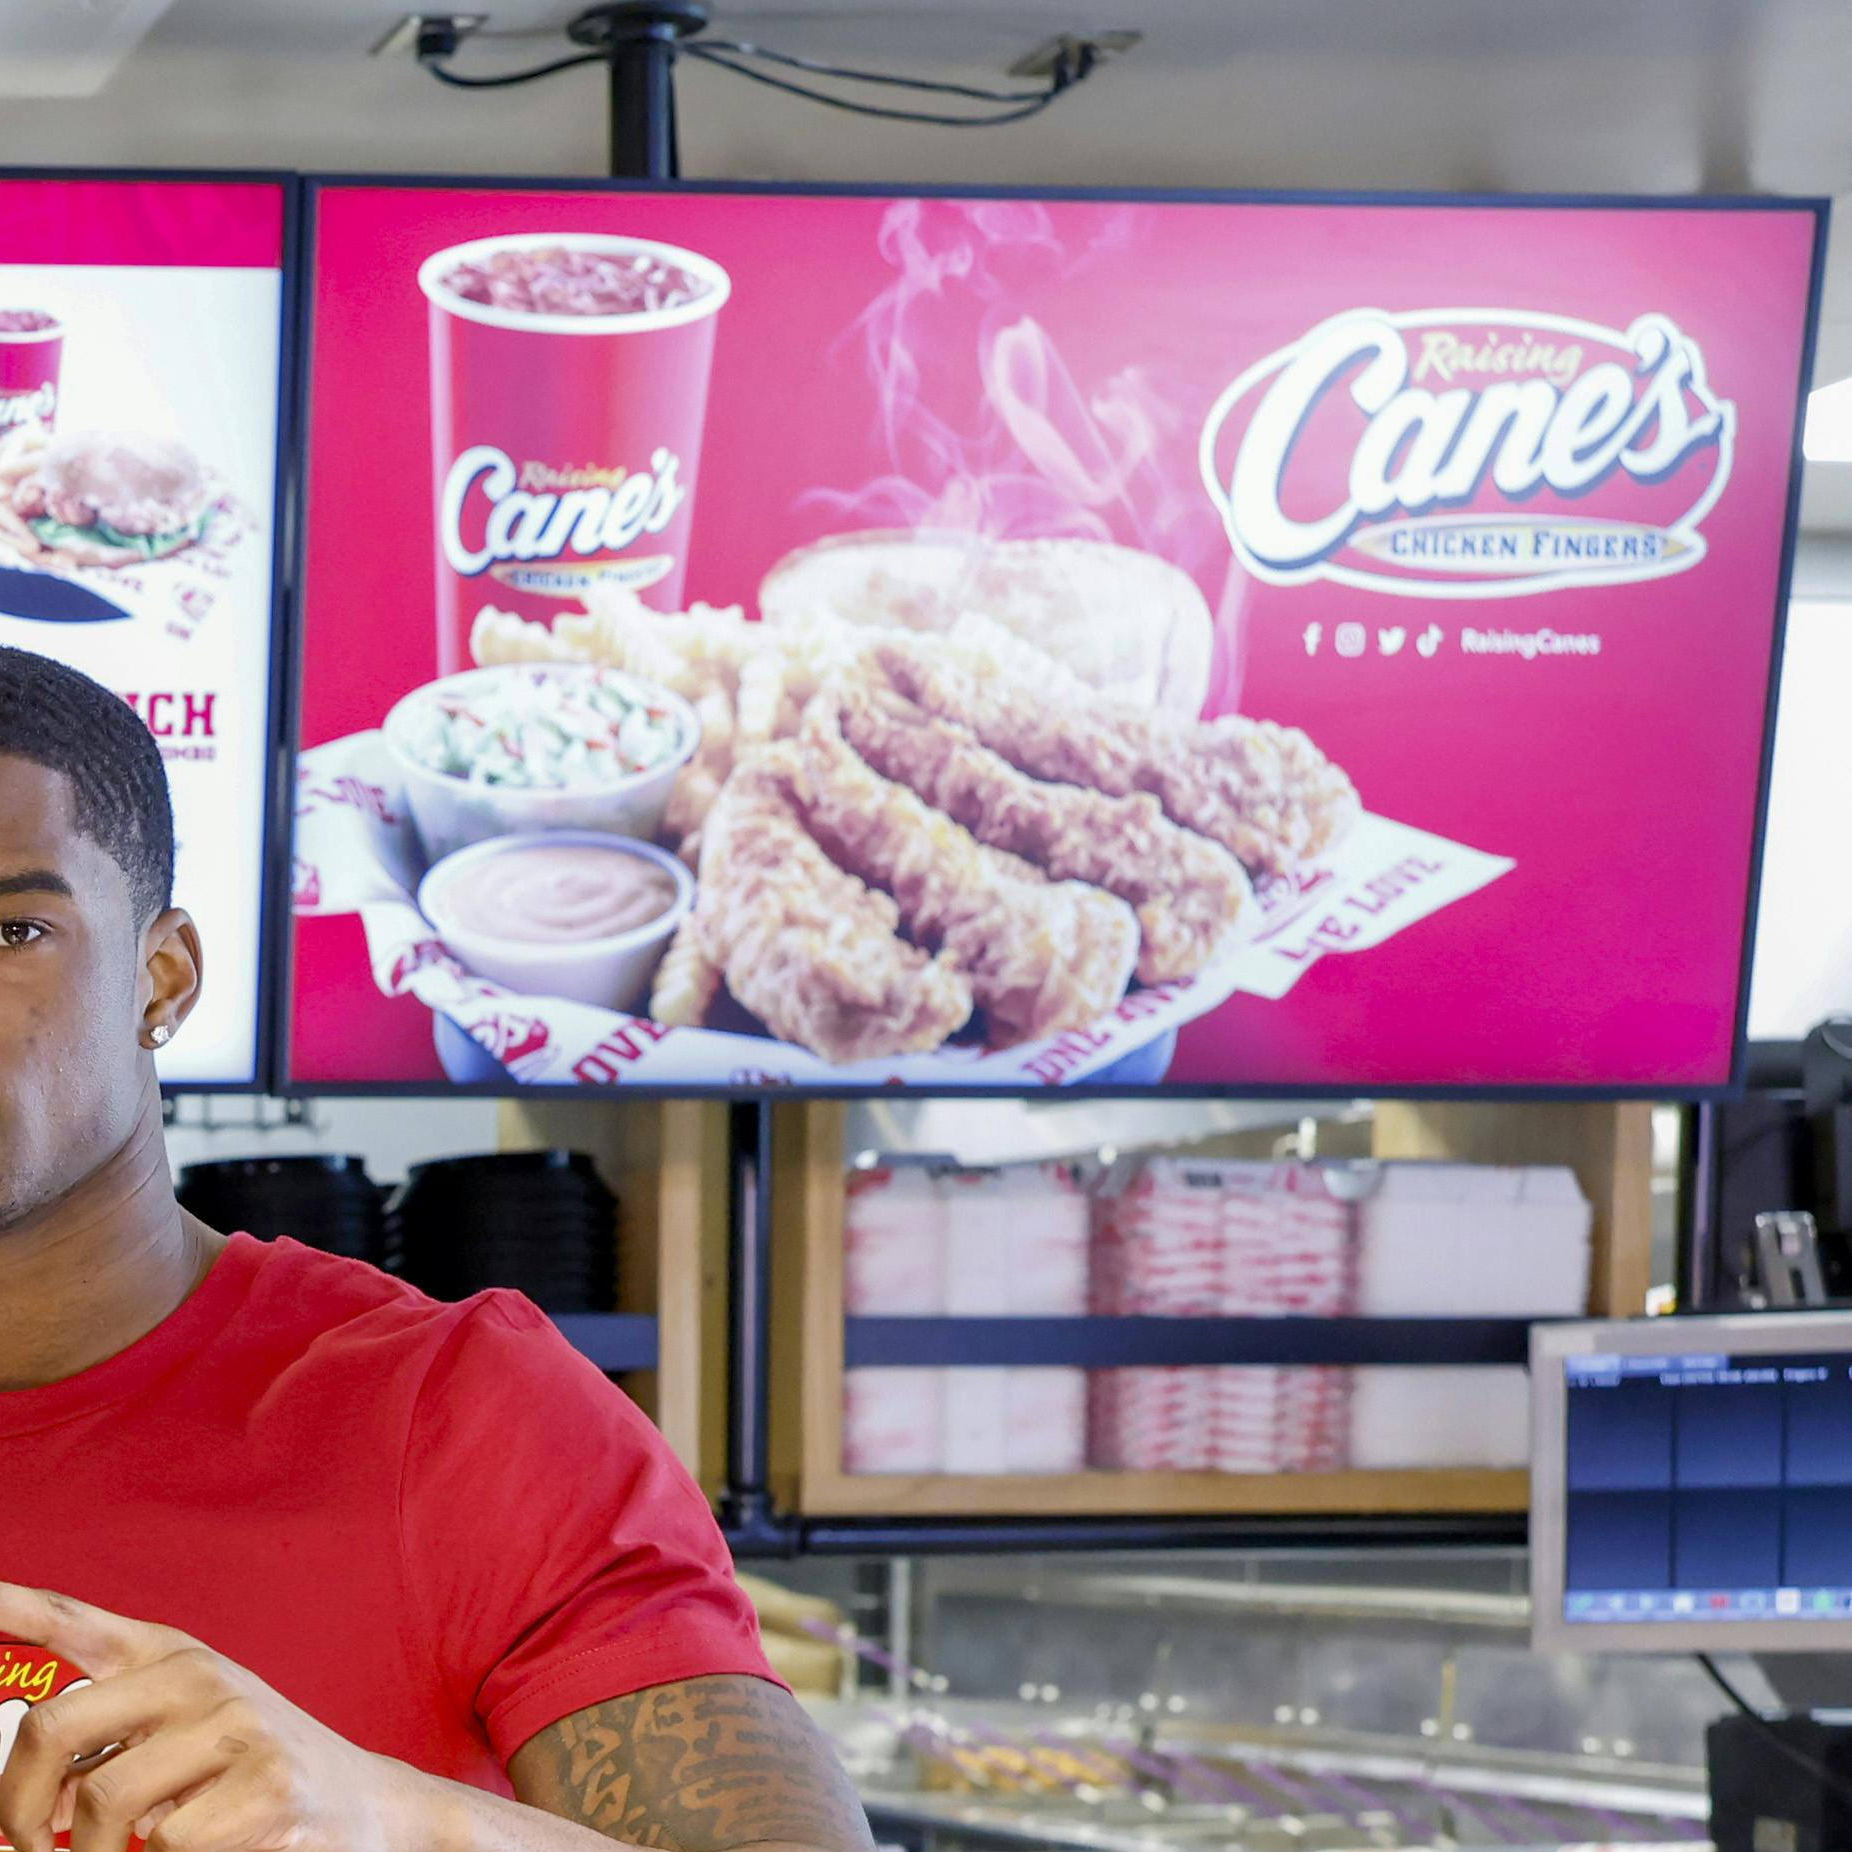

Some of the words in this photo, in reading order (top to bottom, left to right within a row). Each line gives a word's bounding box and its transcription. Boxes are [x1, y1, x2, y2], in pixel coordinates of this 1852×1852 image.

[1412, 331, 1585, 384] Raising
[1231, 317, 1721, 564] Cane's
[442, 445, 687, 578] Cane's
[1389, 527, 1519, 560] CHICKEN
[1531, 527, 1659, 561] FINGERS
[1460, 627, 1603, 660] RaisingCanes
